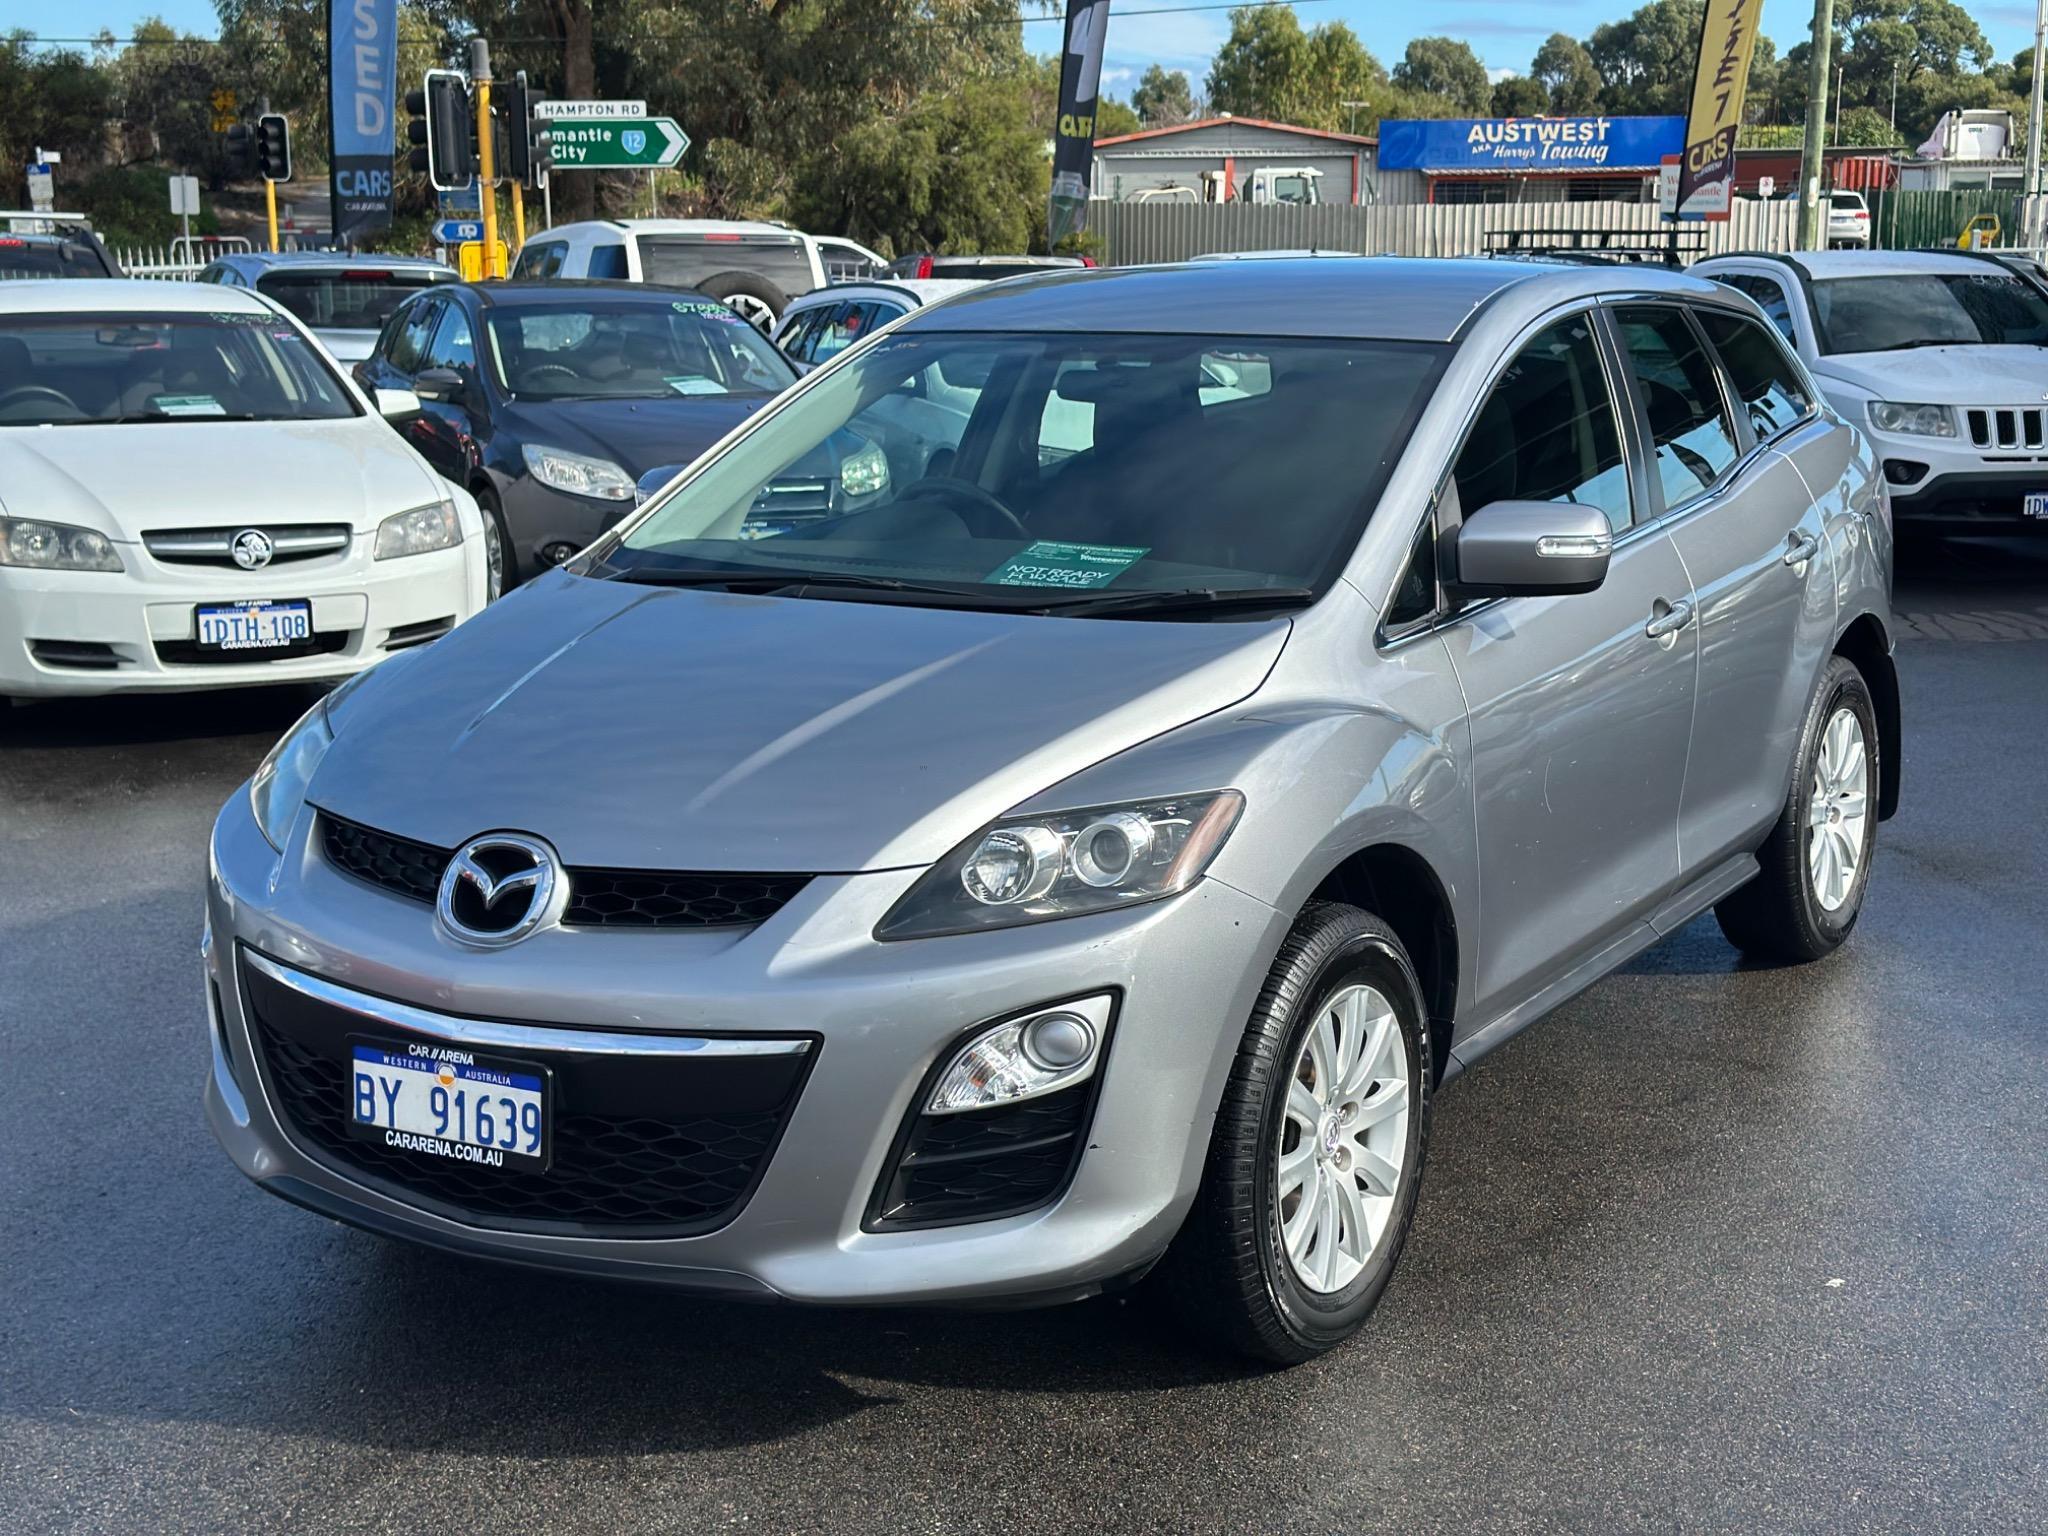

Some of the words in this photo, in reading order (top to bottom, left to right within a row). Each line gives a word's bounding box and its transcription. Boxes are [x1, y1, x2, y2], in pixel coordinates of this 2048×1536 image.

[545, 104, 615, 115] HAMPTON
[622, 104, 640, 114] RD
[628, 135, 641, 147] 12
[1467, 122, 1611, 143] AUSTWEST
[550, 144, 587, 162] City
[1472, 143, 1492, 155] AKA
[1541, 140, 1610, 164] Towing
[336, 170, 391, 197] CARS
[1007, 564, 1049, 575] NOT
[1047, 568, 1110, 579] READY
[1047, 575, 1093, 585] SALE
[383, 1055, 427, 1071] WESTERN
[465, 1069, 512, 1086] AUSTRALIA
[430, 1086, 541, 1154] 91639
[385, 1129, 504, 1168] CARARENA.COM.AU
